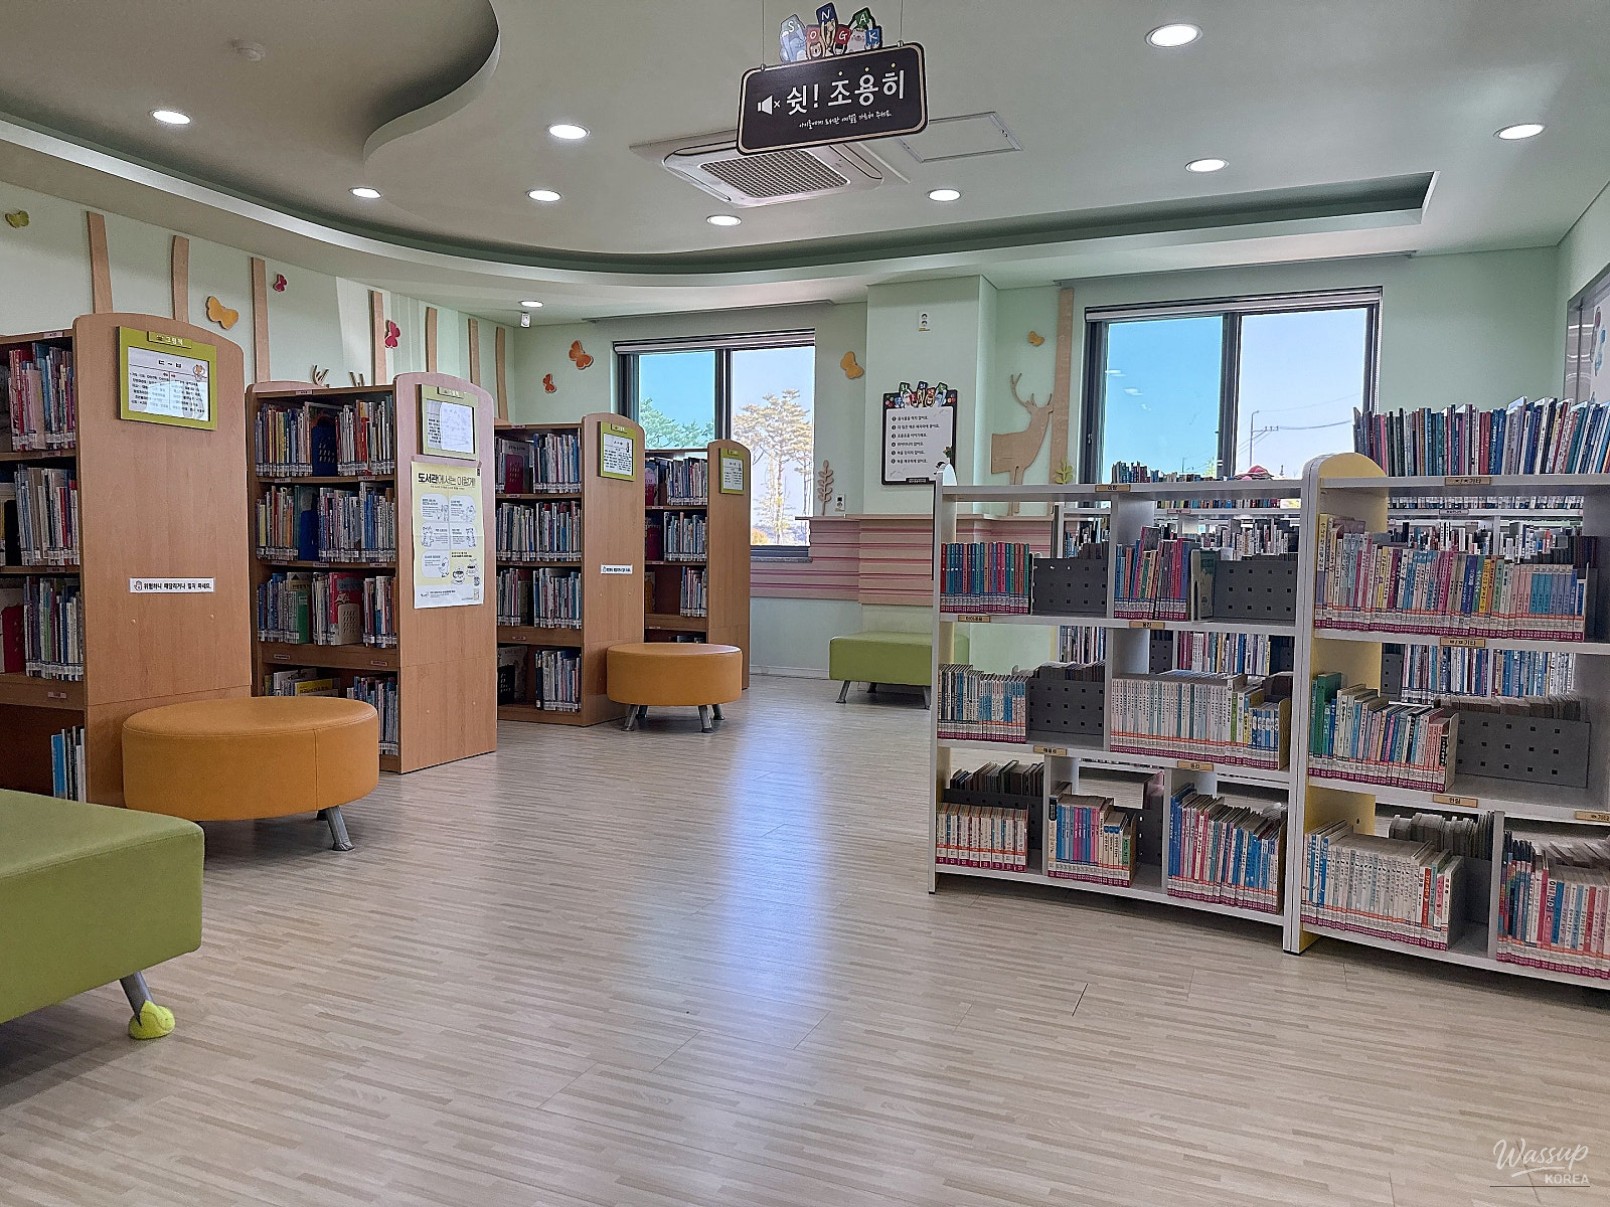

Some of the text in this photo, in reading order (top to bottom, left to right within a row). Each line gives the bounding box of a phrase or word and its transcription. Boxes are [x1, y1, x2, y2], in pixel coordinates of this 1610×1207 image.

[786, 69, 905, 116] 쉿! 조용히
[417, 472, 457, 486] 도서관에서는
